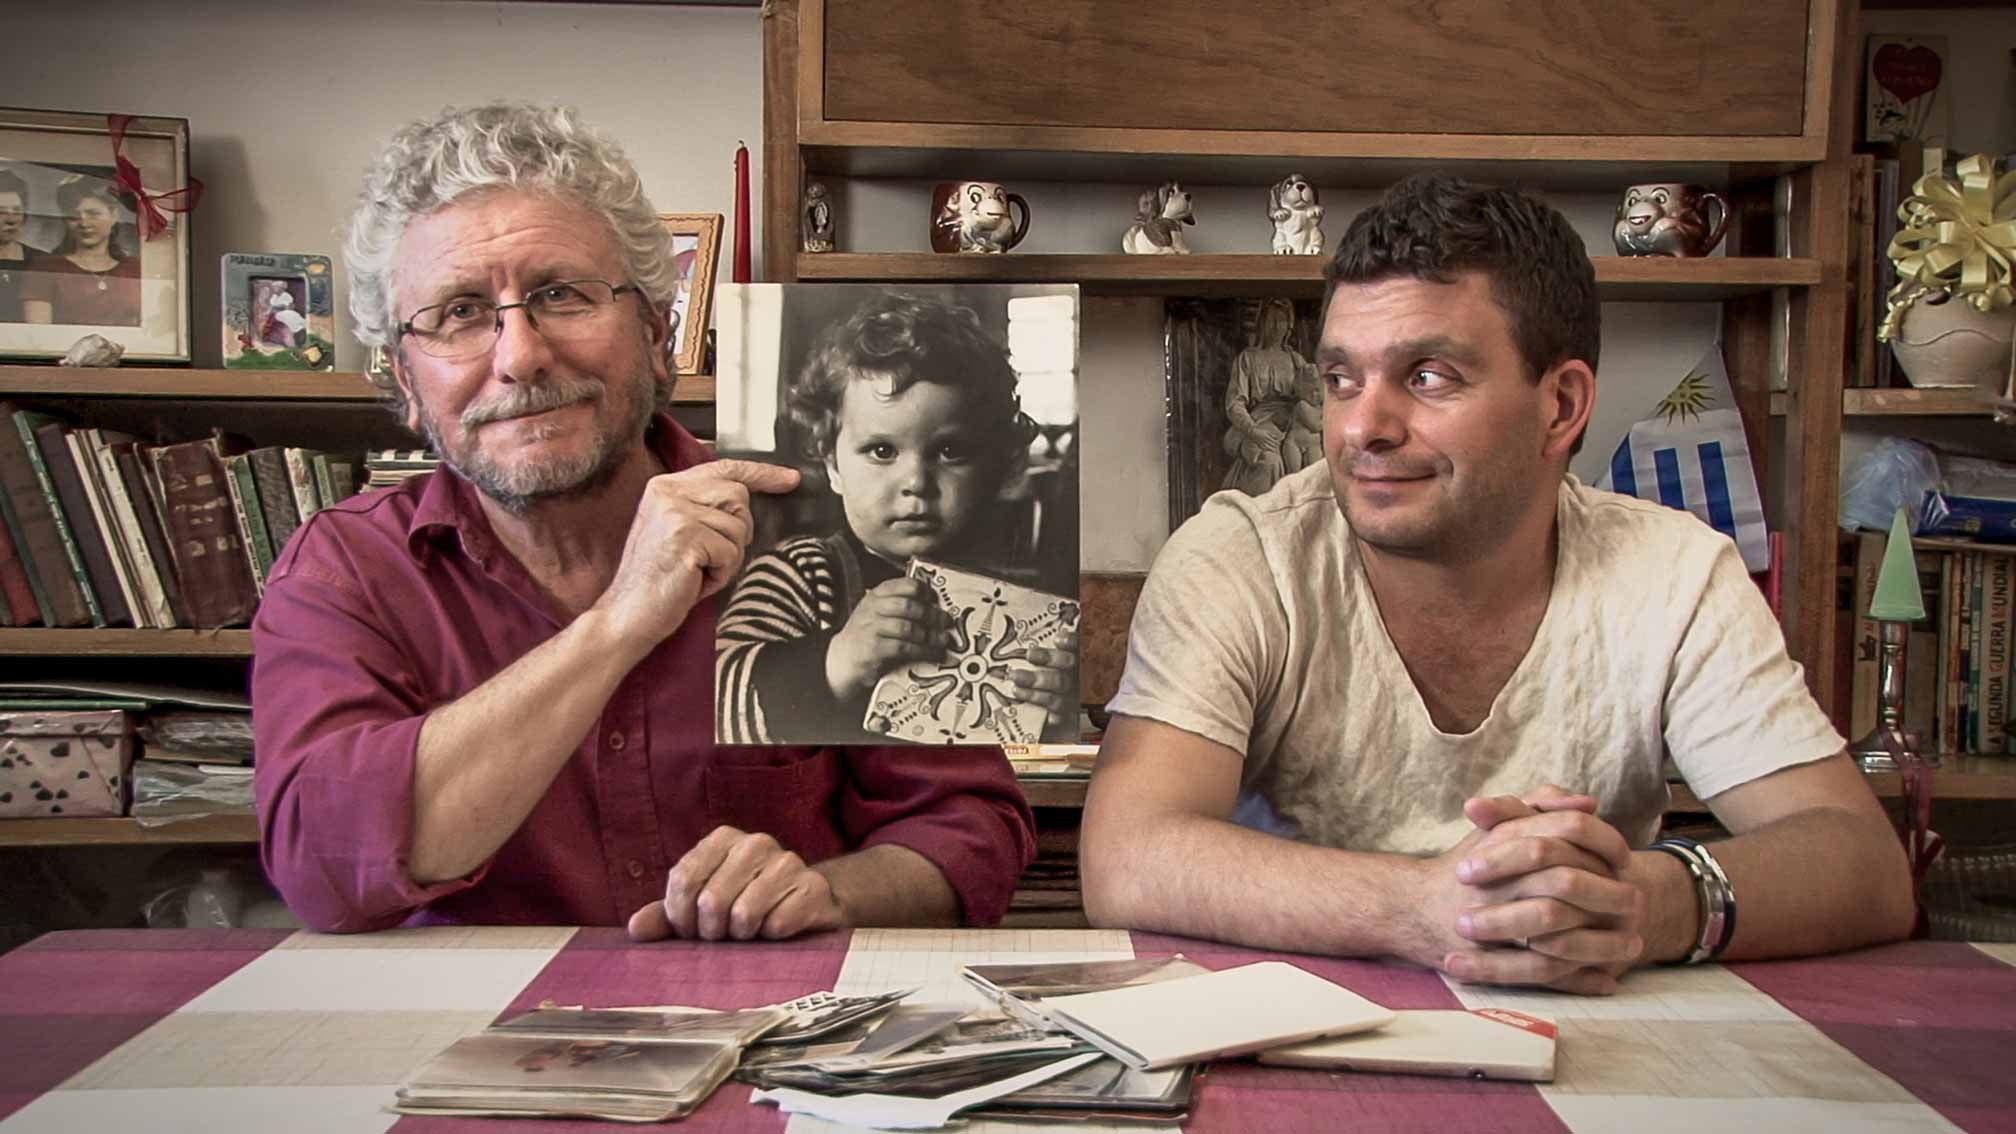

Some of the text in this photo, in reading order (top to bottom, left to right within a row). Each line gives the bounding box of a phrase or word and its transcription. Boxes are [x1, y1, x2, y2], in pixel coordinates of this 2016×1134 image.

[1992, 557, 2009, 618] MUNDIAL
[1989, 620, 2006, 673] GUERRA
[1988, 676, 2004, 734] SEGUNDA
